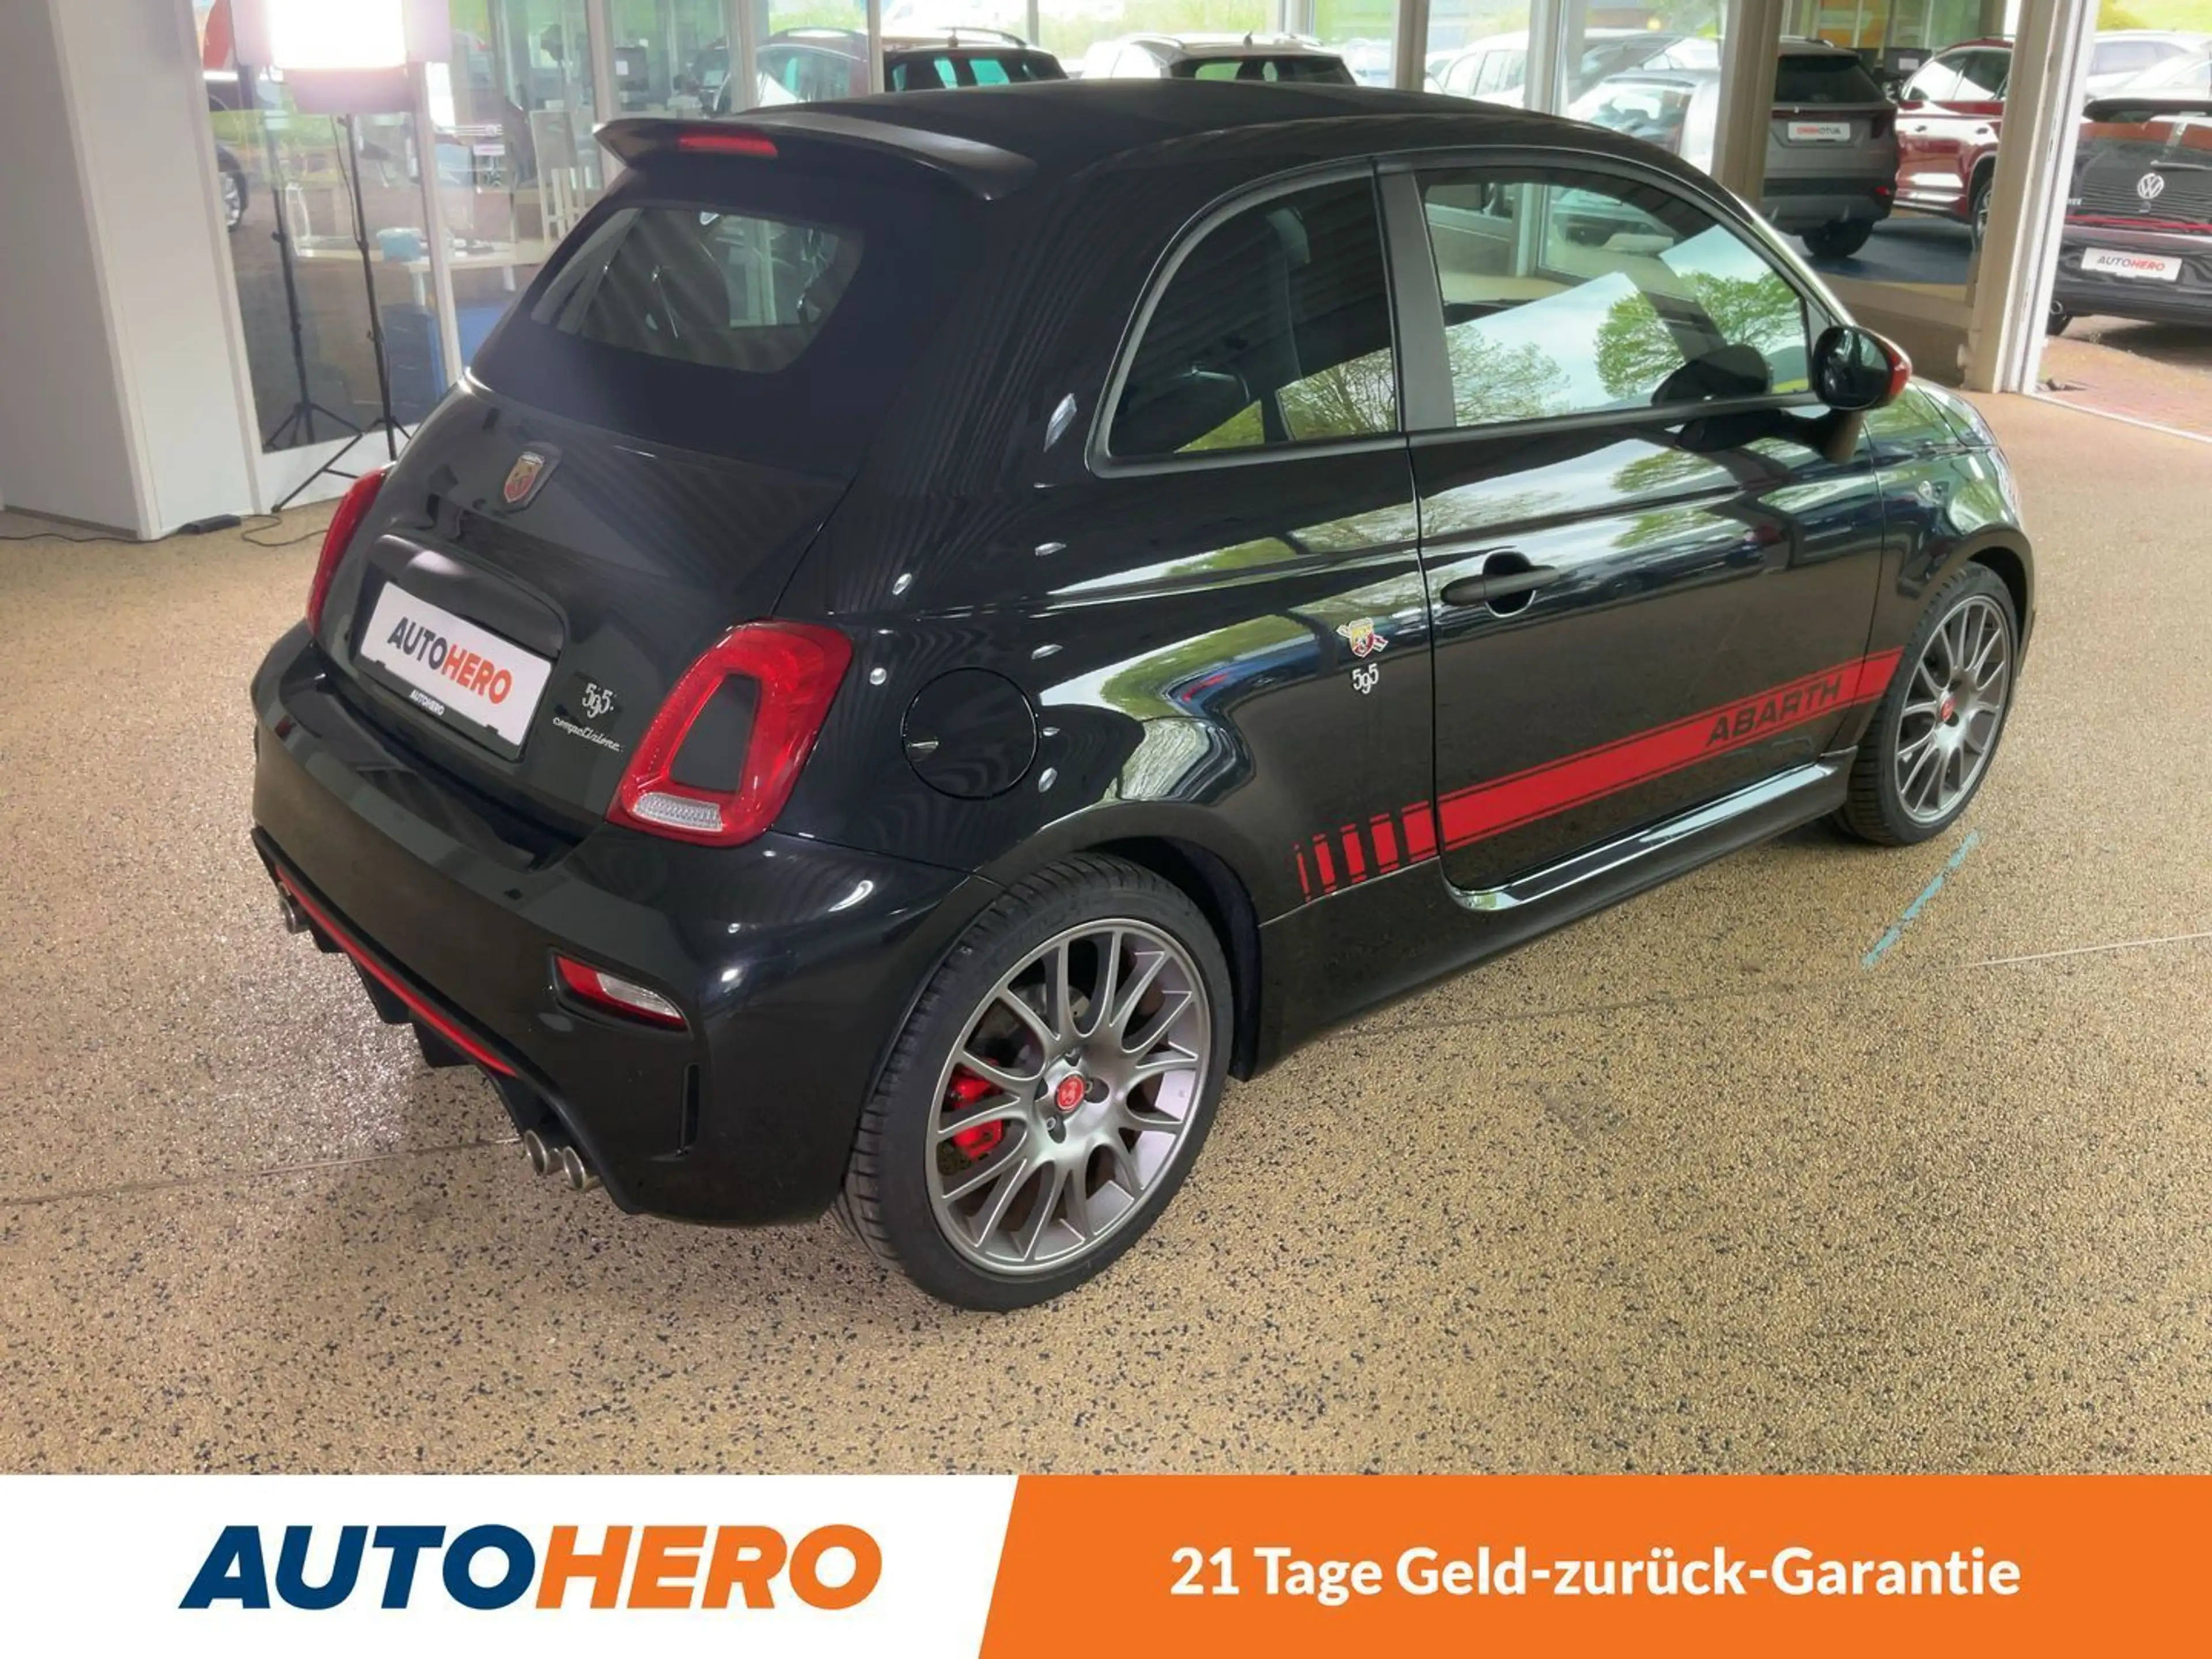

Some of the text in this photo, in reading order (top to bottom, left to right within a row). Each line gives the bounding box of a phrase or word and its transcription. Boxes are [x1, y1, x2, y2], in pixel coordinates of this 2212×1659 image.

[2097, 256, 2166, 272] AUTOHERO
[387, 616, 513, 704] AUTOHERO
[1352, 663, 1379, 694] 595
[409, 690, 445, 715] AUTOHERO
[582, 683, 613, 718] 595
[1705, 673, 1843, 747] ABARTH
